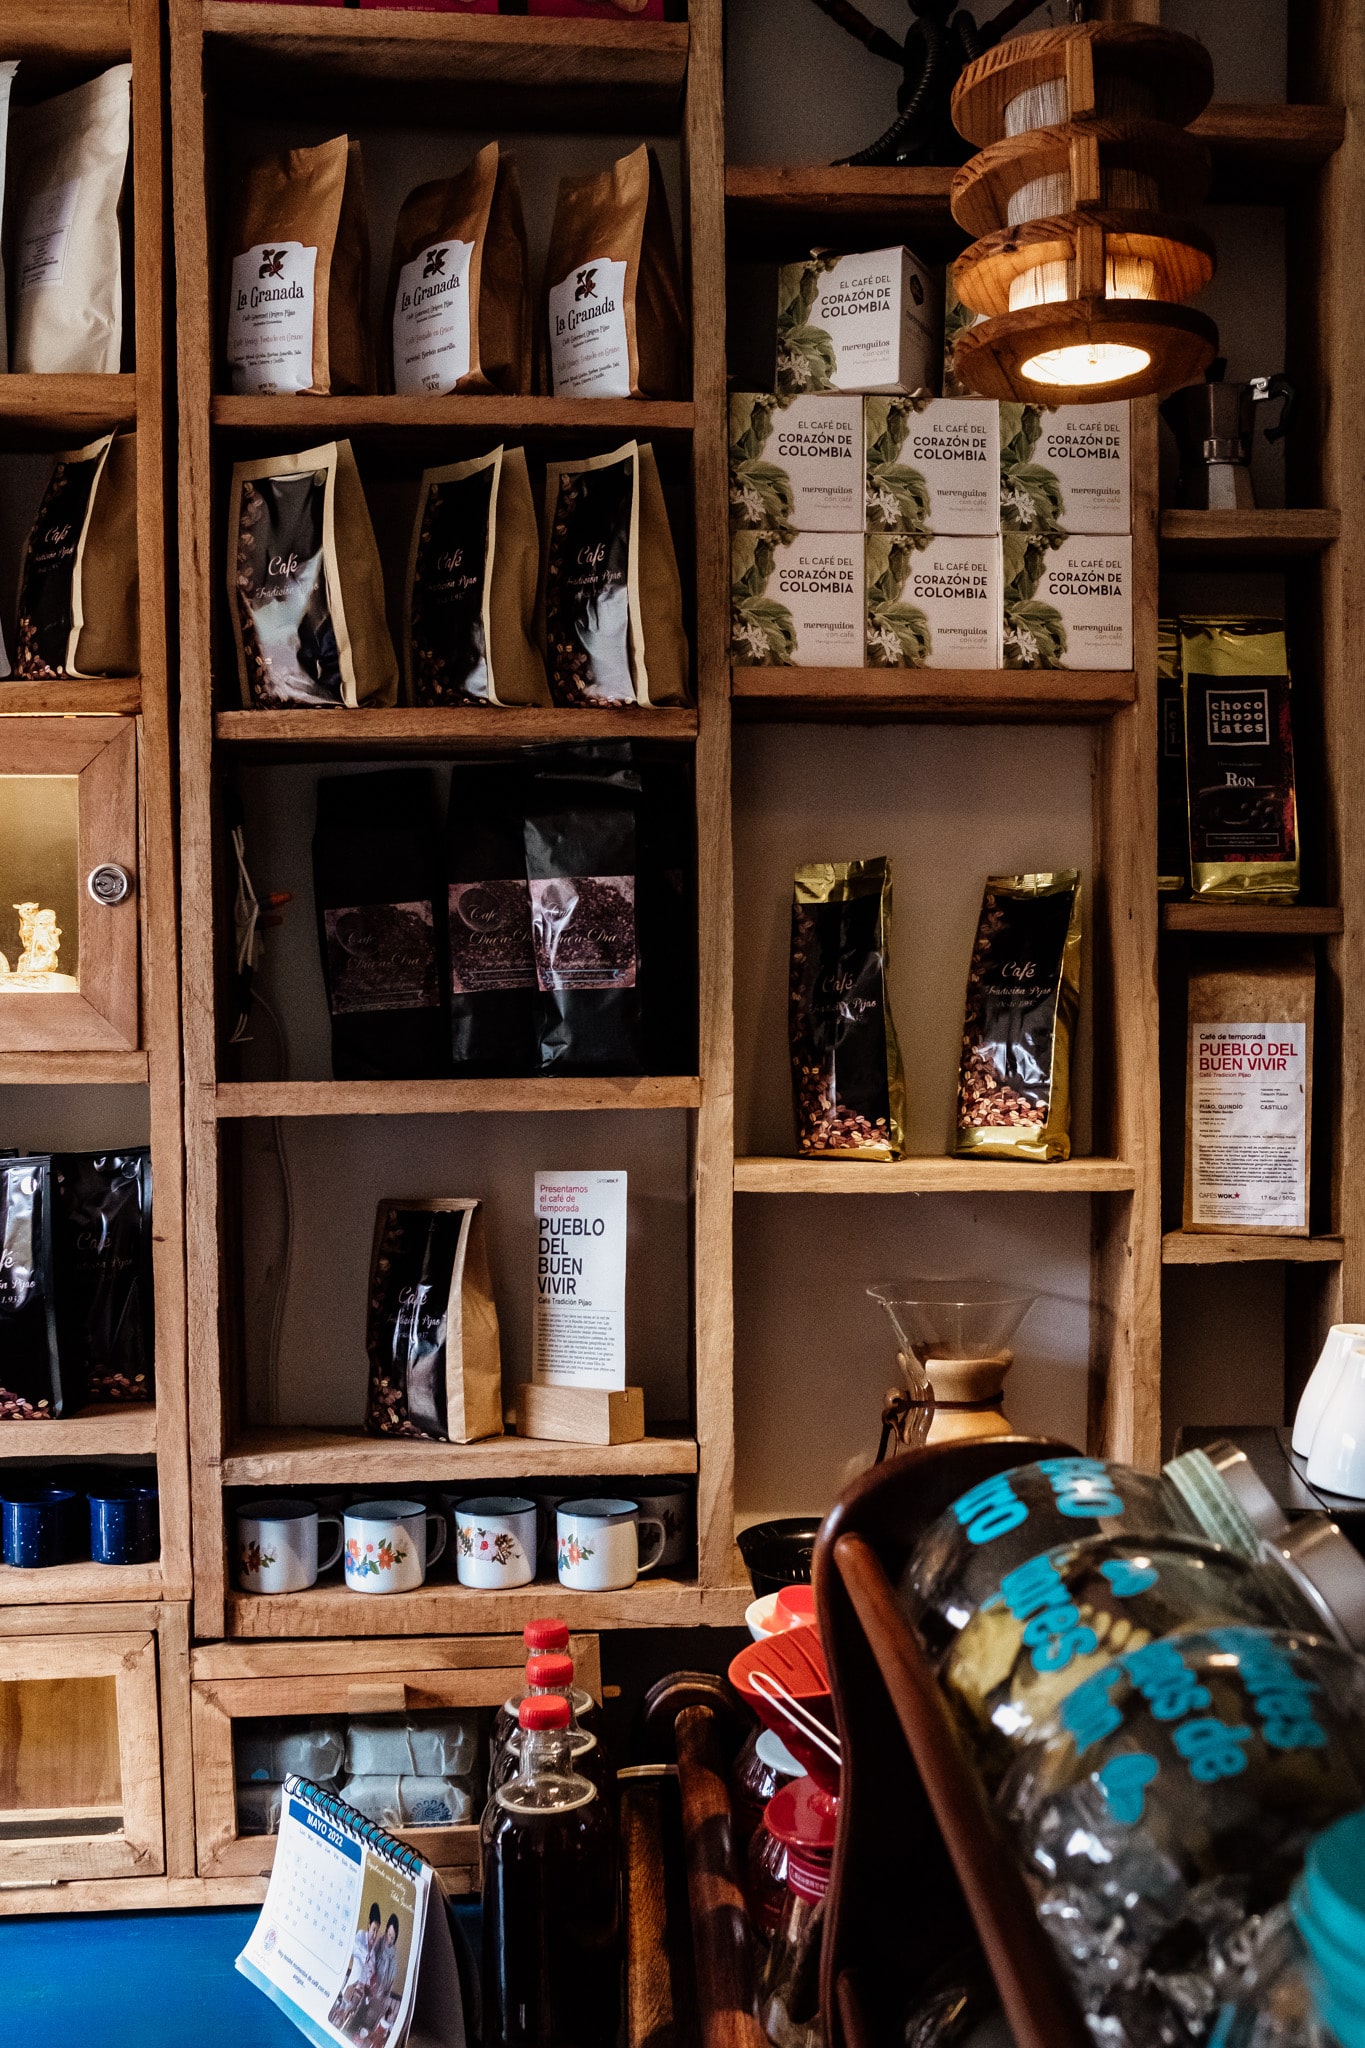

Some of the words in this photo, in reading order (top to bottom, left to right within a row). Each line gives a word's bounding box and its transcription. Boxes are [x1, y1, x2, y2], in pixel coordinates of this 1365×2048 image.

[840, 281, 849, 289] EL
[852, 275, 873, 286] CAFÉ
[876, 276, 891, 284] DEL
[237, 290, 247, 310] La
[251, 281, 304, 308] Granada
[401, 292, 411, 311] La
[414, 274, 460, 306] Granada
[821, 289, 874, 305] CORAZÓN
[877, 288, 891, 298] DE
[821, 301, 890, 318] COLOMBIA
[556, 315, 565, 336] La
[568, 297, 615, 331] Granada
[842, 340, 890, 352] merenguitos
[799, 421, 808, 429] EL
[811, 420, 833, 429] CAFÉ
[836, 422, 852, 430] DEL
[946, 423, 968, 433] CAFÉ
[1079, 422, 1101, 431] CAFÉ
[1104, 424, 1120, 432] DEL
[778, 432, 834, 443] CORAZÓN
[838, 435, 852, 444] DE
[914, 435, 969, 447] CORAZÓN
[973, 439, 986, 447] DE
[1047, 433, 1102, 446] CORAZÓN
[1106, 437, 1120, 446] DE
[779, 445, 852, 458] COLOMBIA
[914, 449, 986, 461] COLOMBIA
[1048, 447, 1120, 459] COLOMBIA
[803, 486, 852, 495] merenguitos
[937, 489, 986, 498] merenguitos
[1072, 487, 1120, 496] merenguitos
[438, 549, 463, 571] Café
[578, 543, 605, 566] Café
[812, 556, 834, 565] CAFÉ
[269, 553, 298, 577] Café
[947, 561, 968, 570] CAFÉ
[1081, 559, 1103, 568] CAFÉ
[780, 568, 836, 579] CORAZÓN
[840, 571, 853, 580] DE
[914, 573, 970, 585] CORAZÓN
[974, 577, 987, 585] DE
[1049, 570, 1104, 582] CORAZÓN
[1108, 574, 1122, 582] DE
[780, 582, 853, 593] COLOMBIA
[915, 587, 987, 599] COLOMBIA
[1050, 584, 1121, 596] COLOMBIA
[804, 622, 854, 631] merenguitos
[938, 627, 987, 636] merenguitos
[1073, 624, 1122, 633] merenguitos
[1211, 701, 1263, 711] choco
[1212, 722, 1264, 734] lates
[1002, 962, 1036, 980] Café
[822, 972, 853, 994] Café
[1200, 1043, 1262, 1056] PUEBLO
[1268, 1044, 1298, 1056] DEL
[1200, 1058, 1242, 1070] BUEN
[1248, 1058, 1287, 1070] VIVIR
[540, 1185, 588, 1193] Presentamos
[540, 1205, 579, 1213] temporada
[540, 1218, 604, 1236] PUEBLO
[539, 1238, 568, 1254] DEL
[539, 1257, 582, 1275] BUEN
[538, 1276, 576, 1295] VIVIR
[578, 1299, 592, 1307] Pijao
[307, 1814, 327, 1834] MAYO
[327, 1828, 343, 1847] 2022
